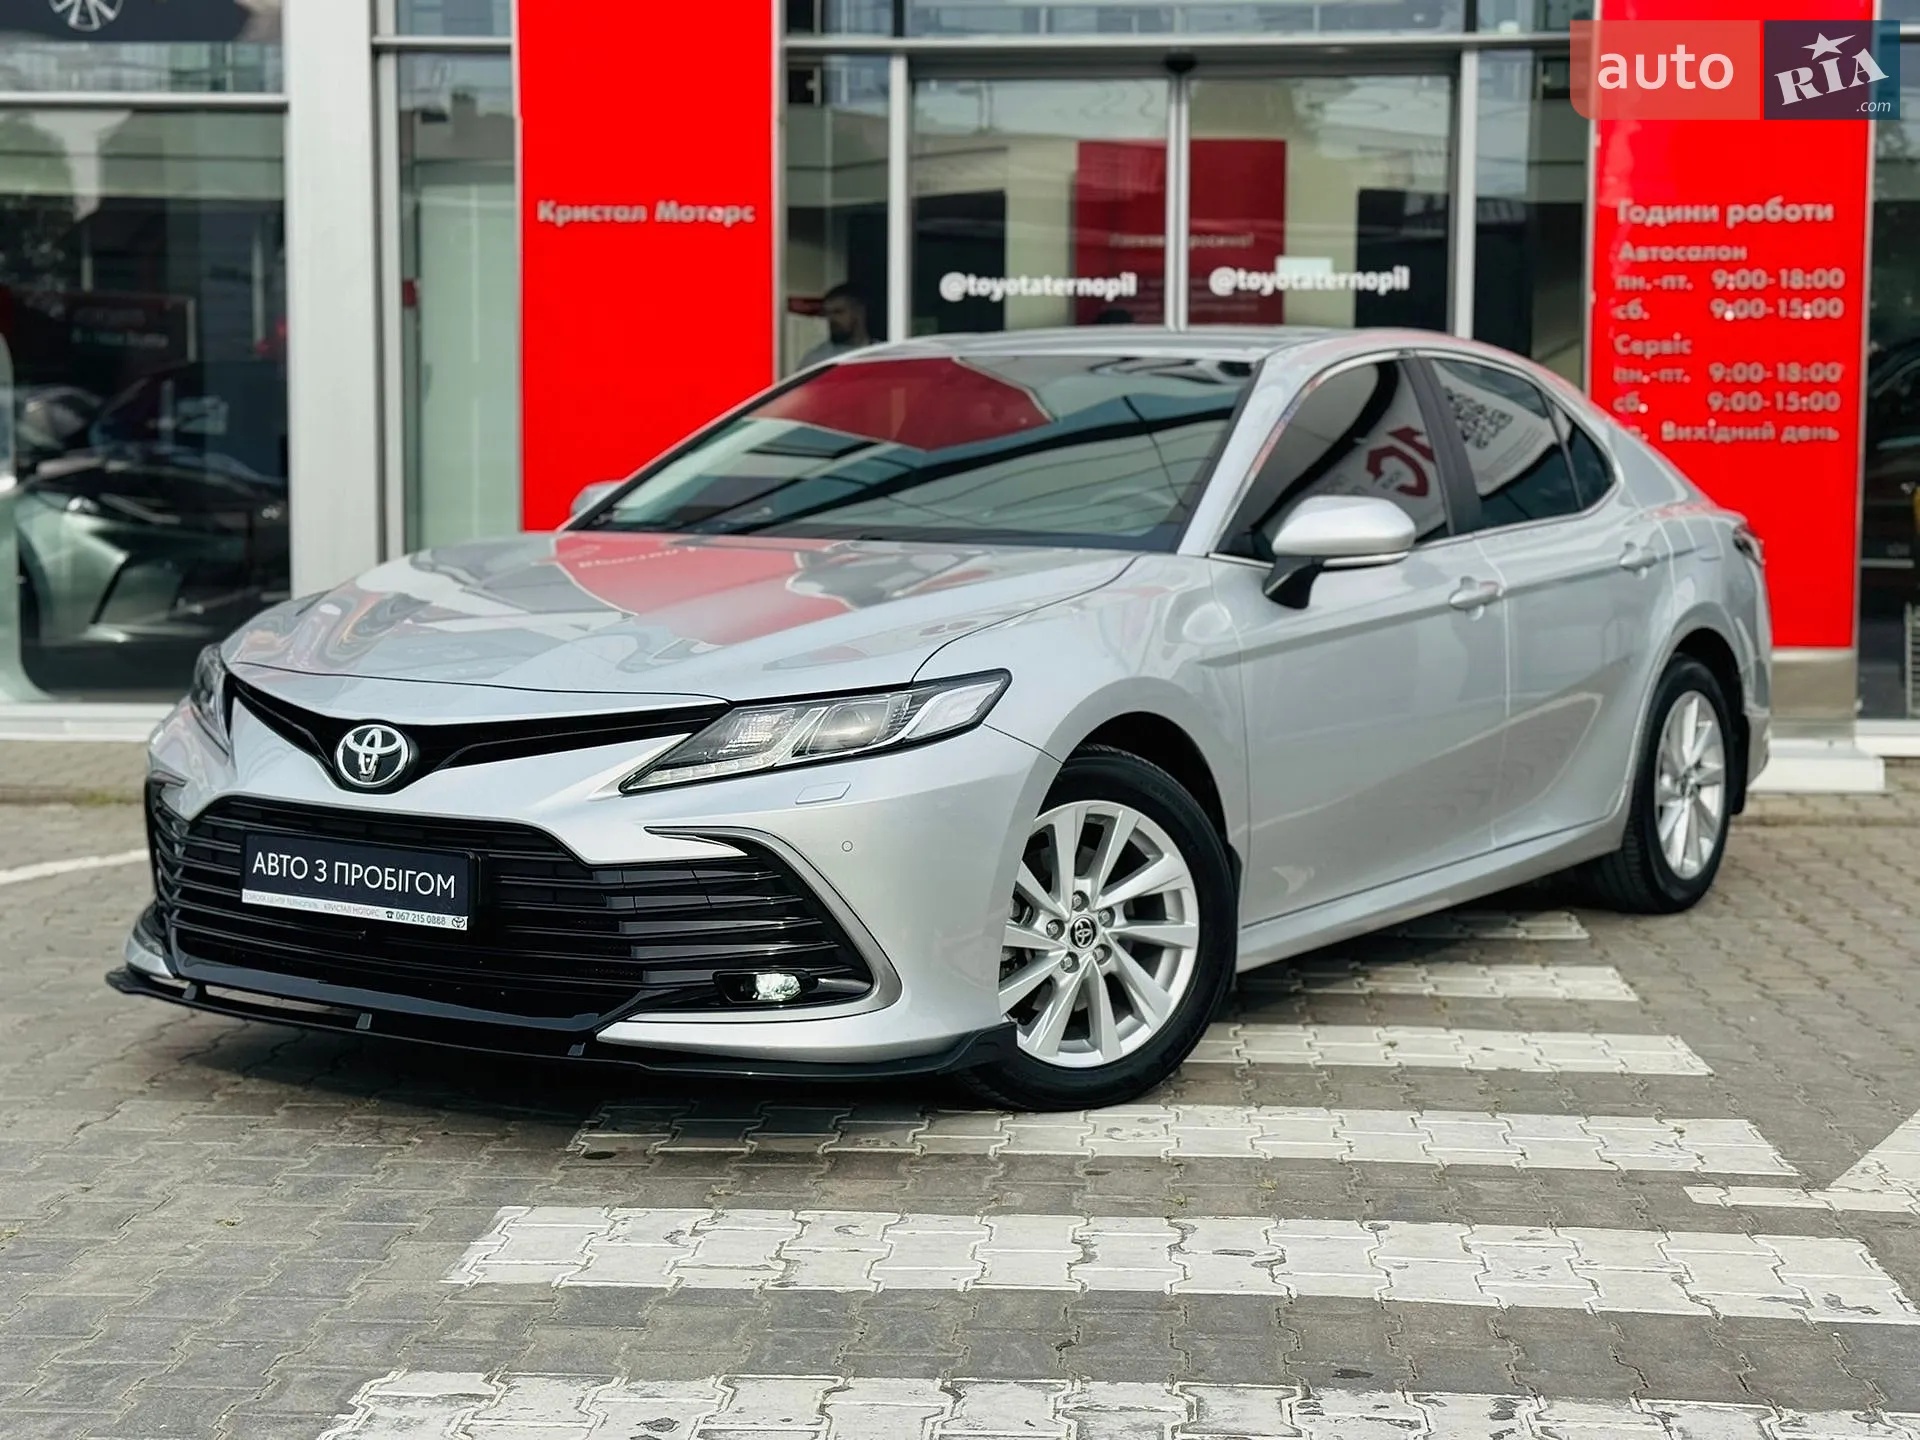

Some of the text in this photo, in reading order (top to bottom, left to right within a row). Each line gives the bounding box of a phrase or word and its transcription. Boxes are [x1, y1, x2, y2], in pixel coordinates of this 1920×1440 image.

[536, 199, 757, 229] Кристал Моторс
[1617, 195, 1835, 230] Години роботи
[1618, 241, 1748, 262] Автосалон
[939, 271, 1138, 302] @toyotaternopil
[1208, 265, 1411, 297] @toyotaternopil
[1614, 332, 1693, 360] Сервіс
[1661, 418, 1775, 444] Вихідний
[1780, 425, 1840, 444] день
[252, 851, 309, 880] АВТО
[334, 861, 455, 898] ПРОБІГОМ
[395, 912, 410, 921] 067
[412, 914, 426, 923] 215
